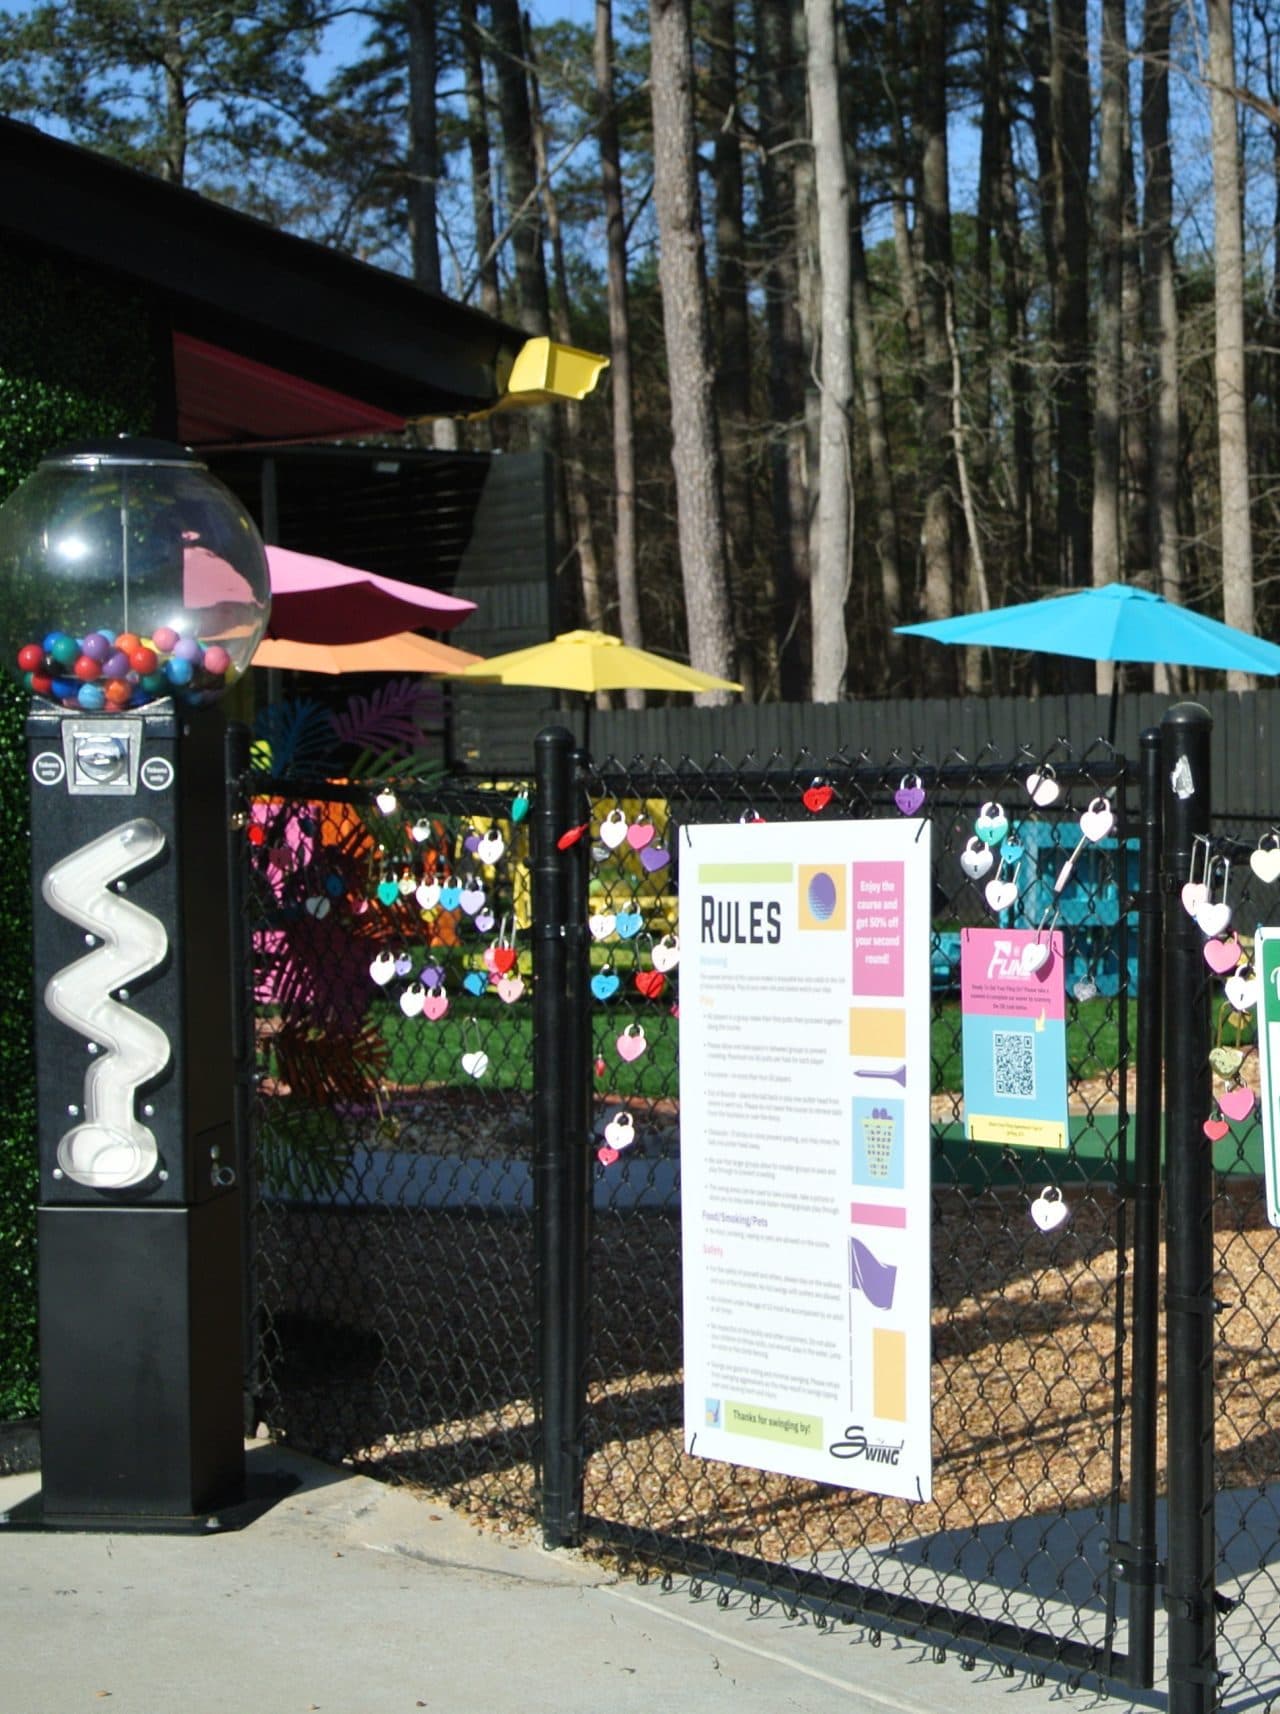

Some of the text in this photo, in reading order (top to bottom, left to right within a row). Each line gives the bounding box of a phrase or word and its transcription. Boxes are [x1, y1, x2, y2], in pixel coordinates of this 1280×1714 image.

[859, 879, 895, 893] Enjoy the
[857, 898, 898, 910] course and
[701, 895, 781, 944] RULES
[856, 916, 899, 930] get 50% off
[855, 935, 900, 948] your second
[987, 940, 1032, 979] FLIN
[733, 1409, 811, 1436] Thanks for swinging by!
